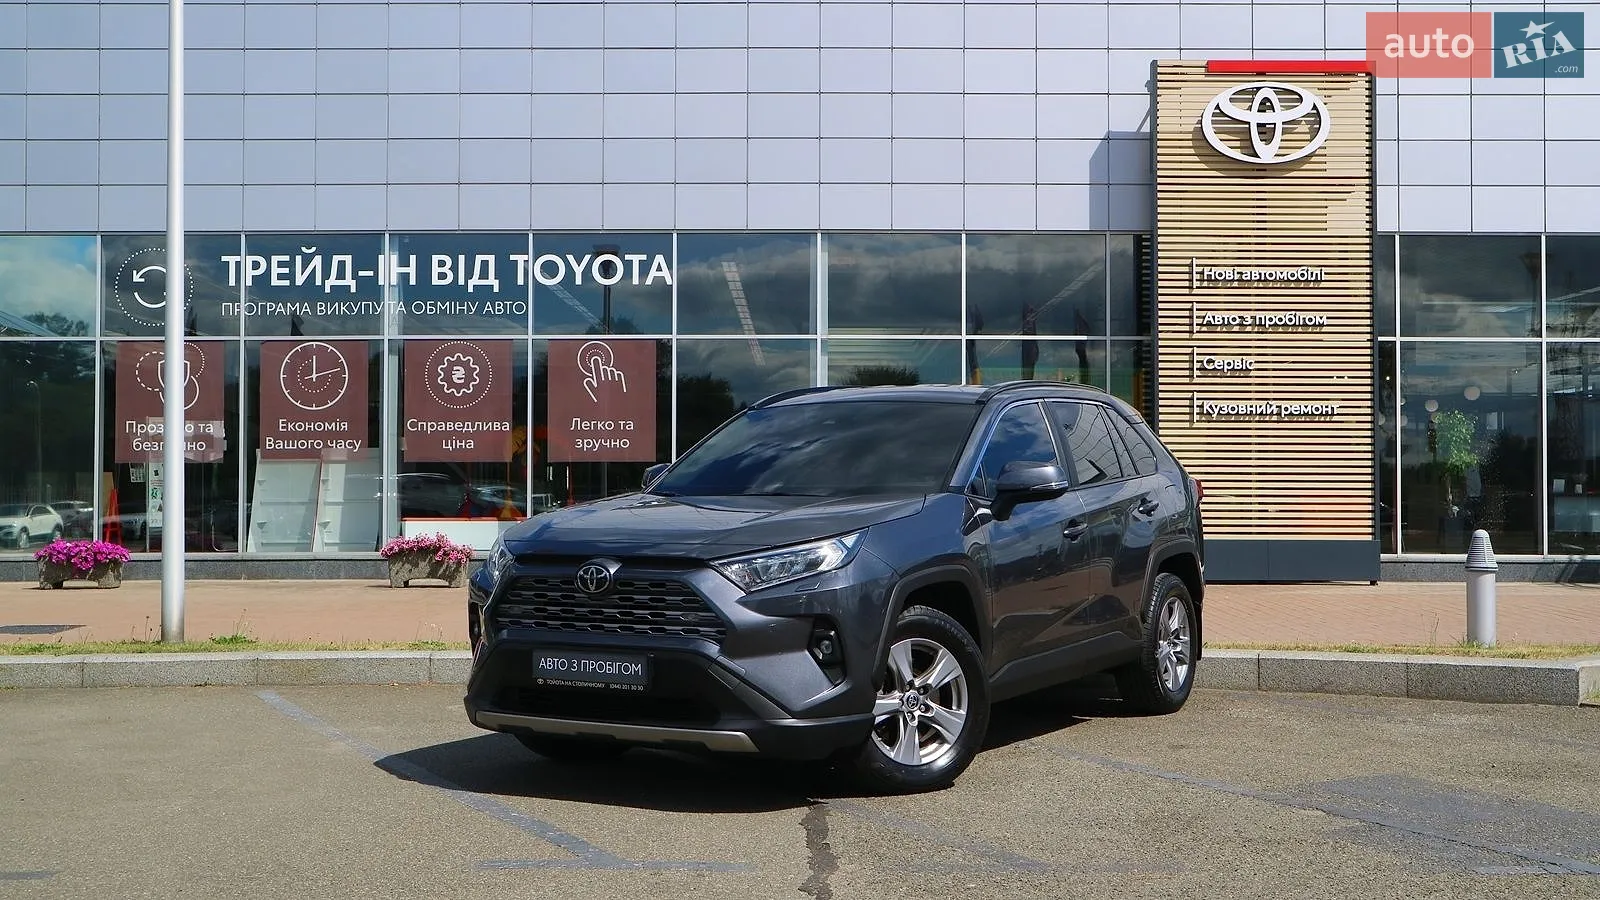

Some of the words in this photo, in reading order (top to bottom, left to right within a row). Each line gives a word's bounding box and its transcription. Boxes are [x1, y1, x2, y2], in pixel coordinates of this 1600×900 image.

[221, 246, 417, 293] ТРЕЙД-ІН
[431, 254, 499, 293] ВІД
[510, 253, 673, 286] TOYOTA
[1203, 268, 1240, 281] Нові
[1242, 266, 1325, 281] автомобілі
[221, 301, 312, 316] ПРОГРАМА
[317, 301, 384, 316] ВИКУПУ
[411, 300, 479, 315] ОБМІНУ
[482, 300, 527, 315] АВТО
[1202, 313, 1241, 325] Авто
[1255, 311, 1328, 328] пробігом
[1203, 356, 1255, 373] Сервіс
[1203, 401, 1278, 418] Кузовний
[1280, 404, 1340, 418] ремонт
[125, 420, 194, 436] Прозо
[198, 423, 214, 433] та
[279, 418, 348, 431] Економія
[406, 418, 510, 434] Справедлива
[570, 417, 615, 431] Легко
[618, 420, 634, 431] та
[265, 436, 323, 450] Вашого
[327, 439, 362, 452] часу
[442, 436, 474, 451] ціна
[574, 438, 630, 452] зручно
[538, 657, 569, 671] АВТО
[580, 660, 642, 676] ПРОБІГОМ
